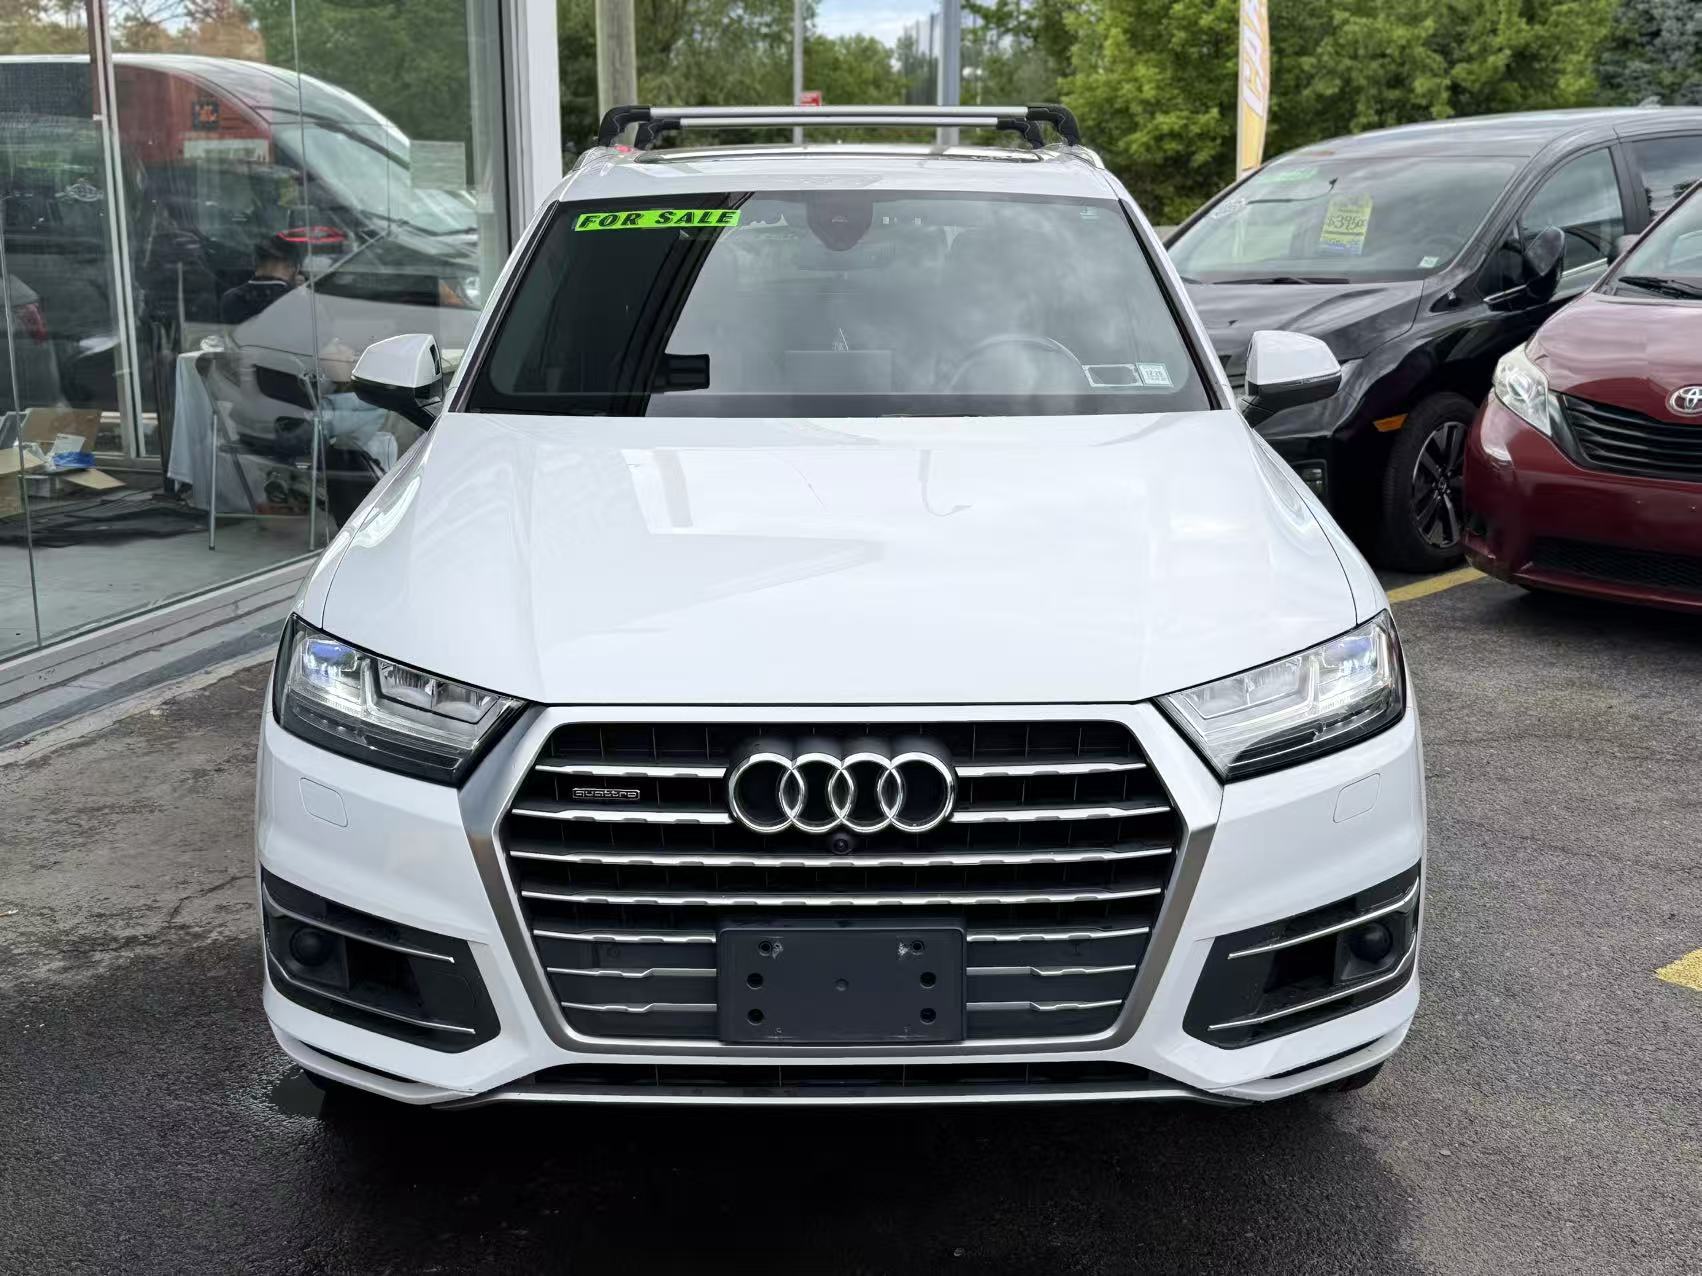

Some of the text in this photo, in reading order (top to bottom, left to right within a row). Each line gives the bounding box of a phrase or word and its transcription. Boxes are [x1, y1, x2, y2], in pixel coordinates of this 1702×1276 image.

[578, 210, 738, 229] FOR SALE
[575, 790, 637, 799] quattro
